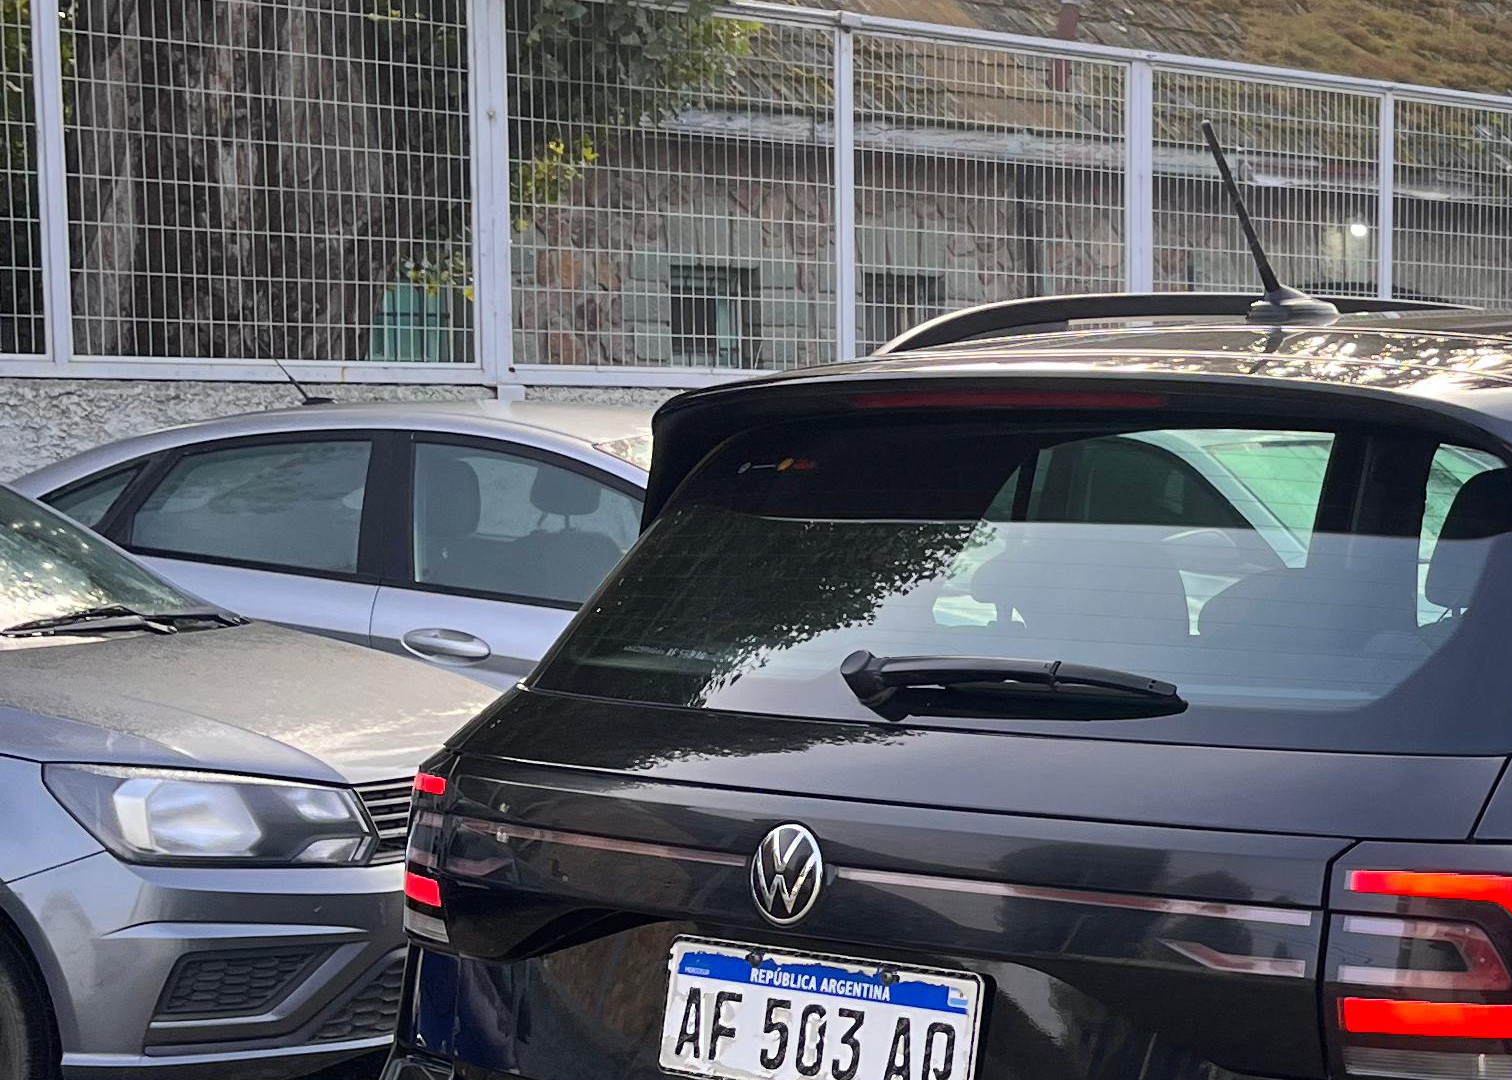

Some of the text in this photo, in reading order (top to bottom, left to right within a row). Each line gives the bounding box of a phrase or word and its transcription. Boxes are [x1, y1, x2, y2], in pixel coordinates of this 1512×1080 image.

[750, 967, 890, 1002] REPÚBLICA ARGENTINA
[675, 987, 743, 1060] AF
